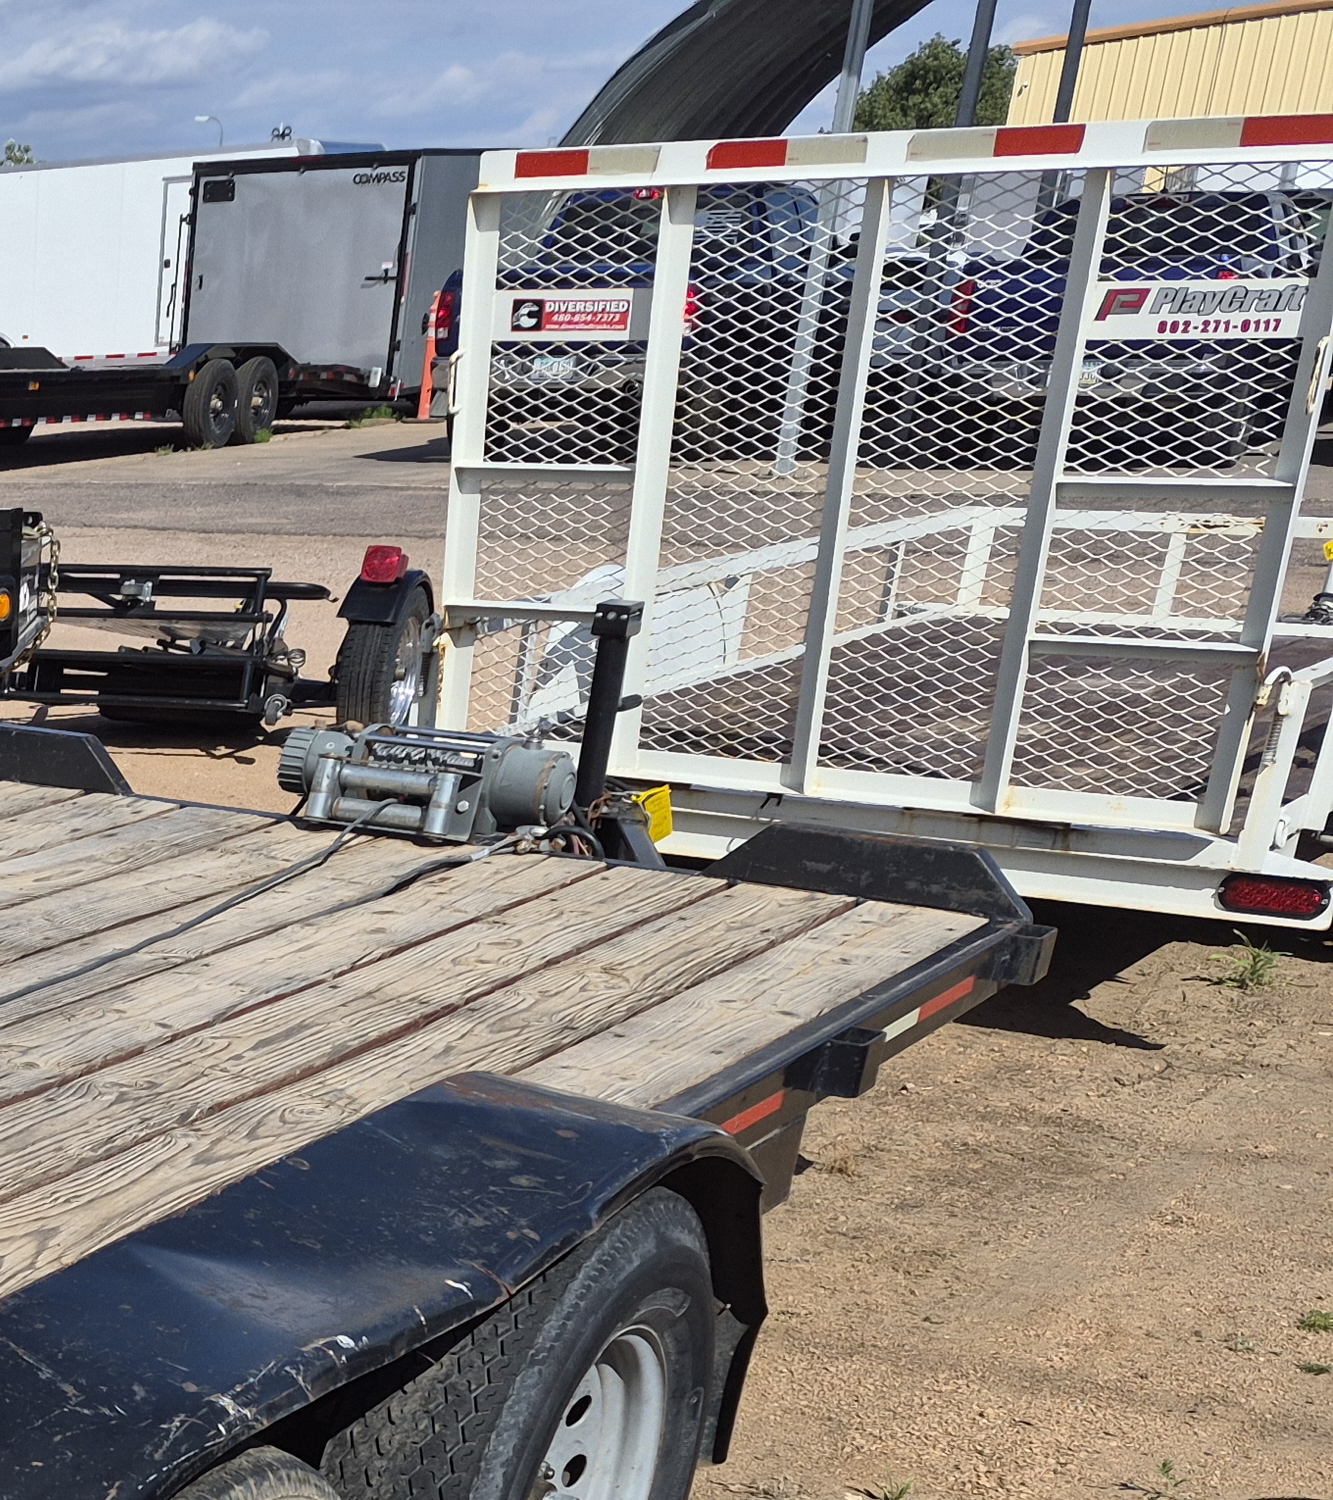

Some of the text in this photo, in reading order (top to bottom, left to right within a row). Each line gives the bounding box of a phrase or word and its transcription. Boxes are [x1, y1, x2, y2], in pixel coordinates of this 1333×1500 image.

[353, 171, 406, 185] COMPASS
[545, 301, 629, 312] DIVERSIFIED
[1148, 284, 1309, 316] PlayCraft
